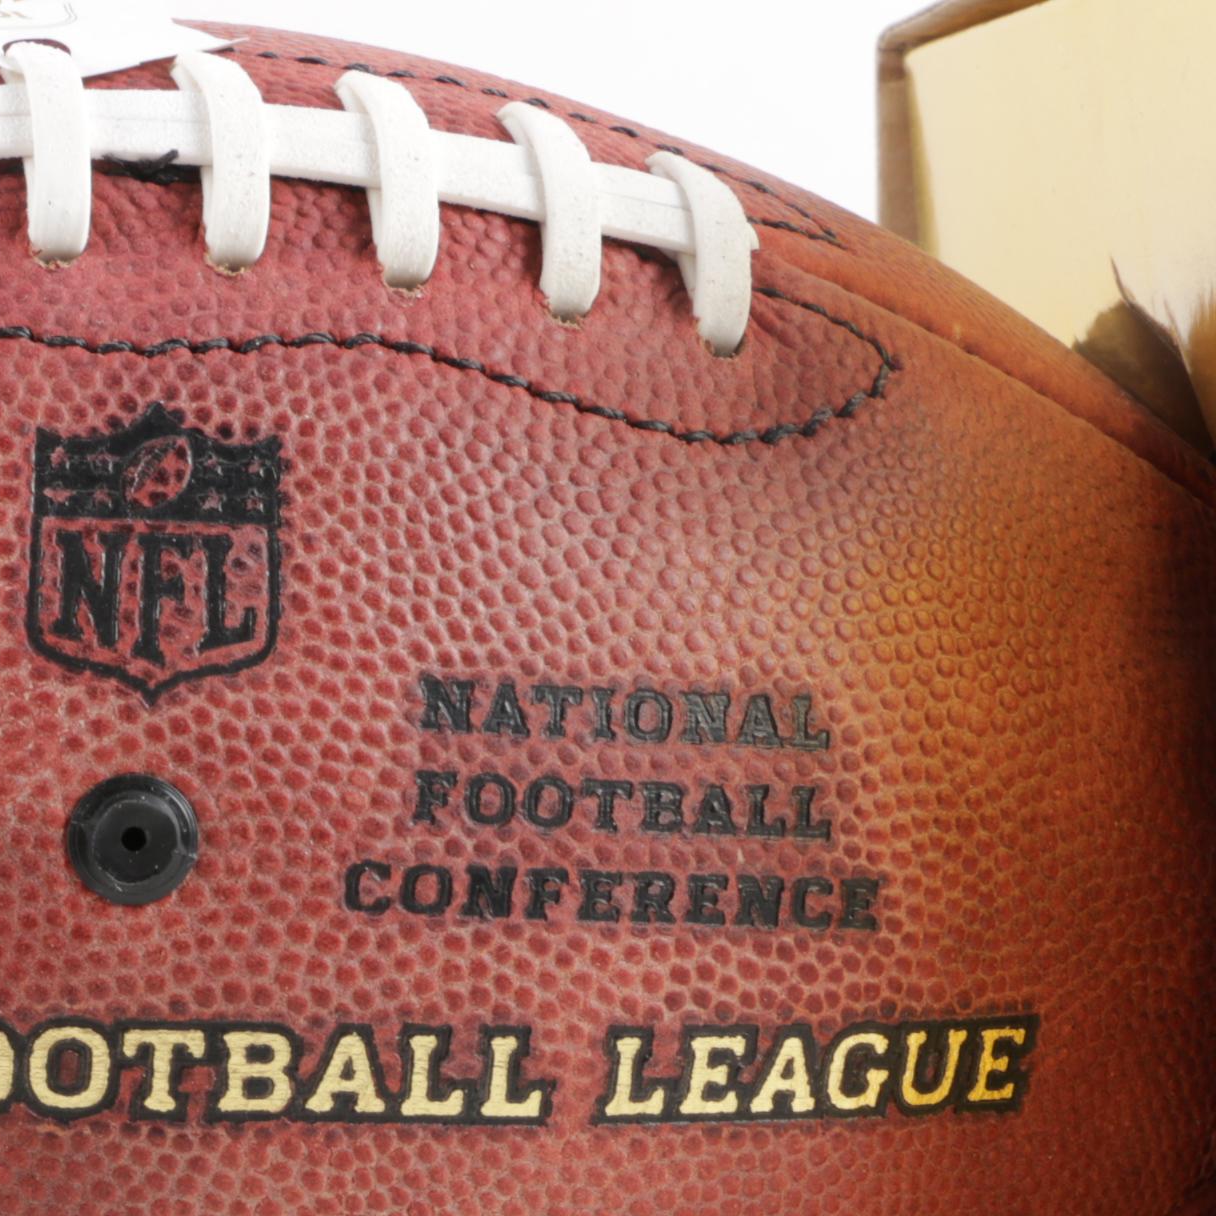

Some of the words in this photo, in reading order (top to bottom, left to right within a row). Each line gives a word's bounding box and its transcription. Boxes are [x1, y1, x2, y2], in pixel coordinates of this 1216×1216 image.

[49, 529, 259, 669] NFL
[418, 675, 831, 752] NATIONAL
[412, 770, 832, 842] FOOTBALL
[343, 861, 879, 931] CONFERENCE
[599, 1020, 1034, 1121] LEAGUE
